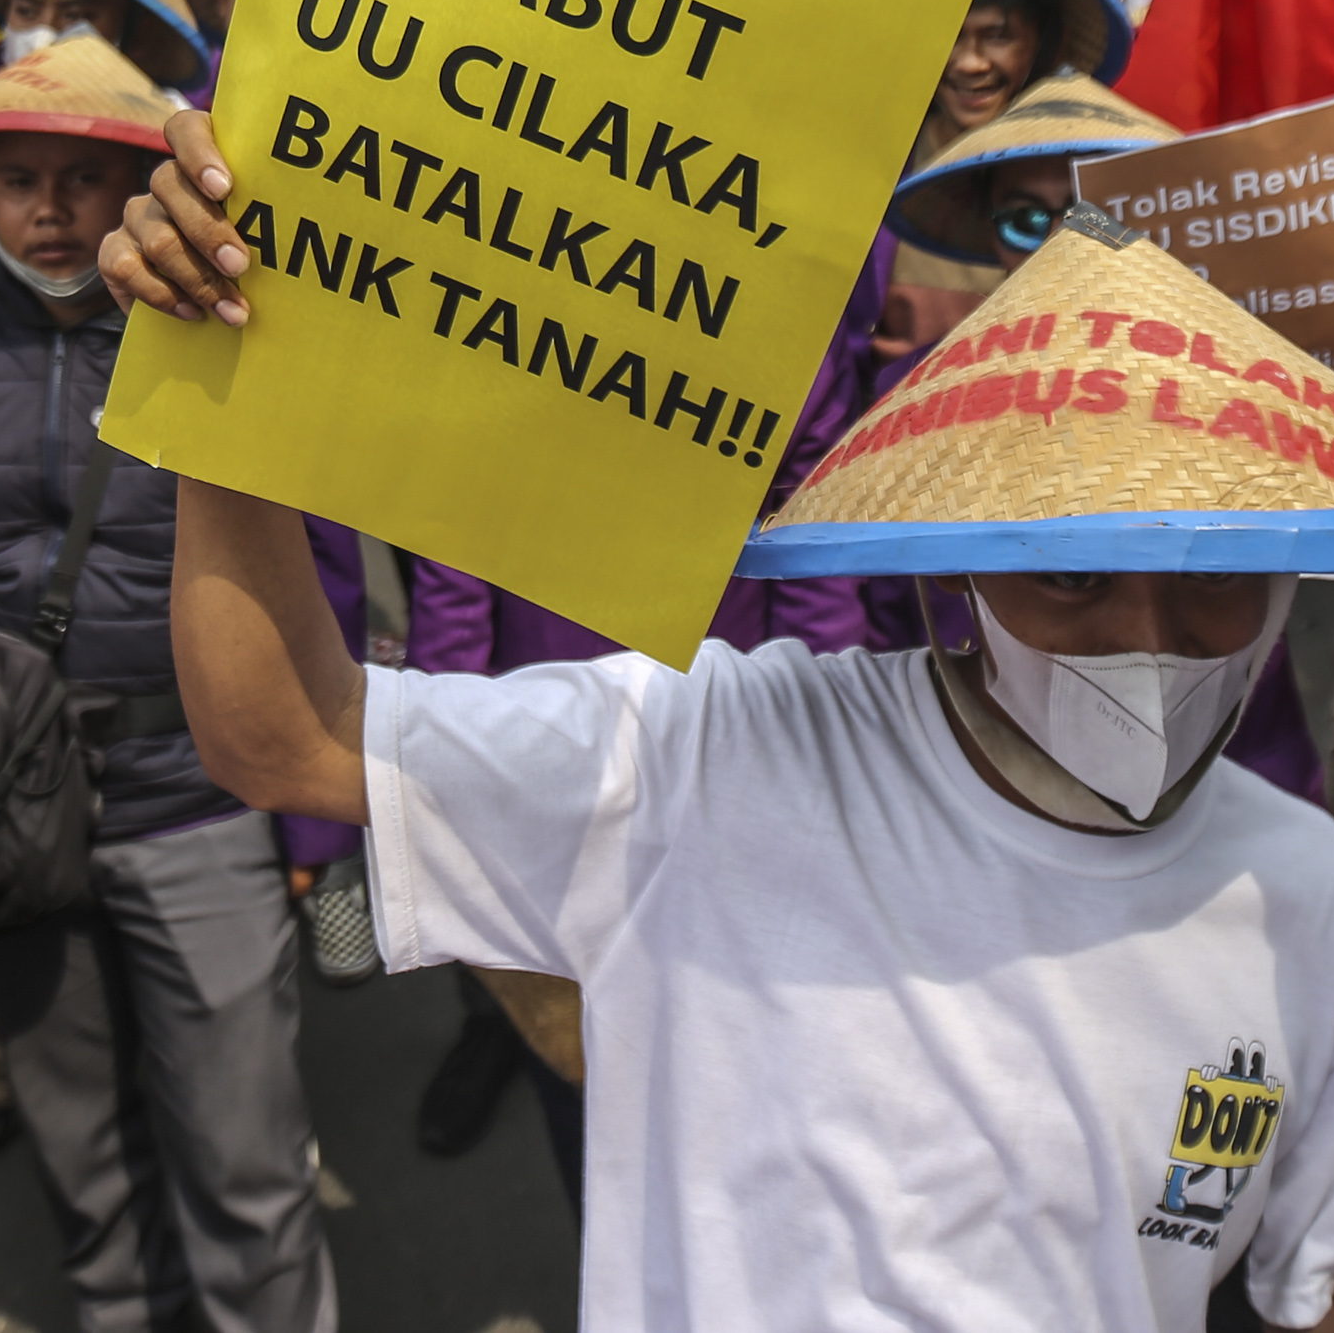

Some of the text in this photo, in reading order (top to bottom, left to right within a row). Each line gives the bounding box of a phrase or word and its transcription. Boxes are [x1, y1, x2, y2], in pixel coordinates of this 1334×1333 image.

[271, 94, 741, 340] BATALKAN
[439, 44, 787, 251] CILAKA,
[1107, 180, 1219, 222] Tolak
[236, 199, 780, 469] ANK TANAH!!
[1138, 1217, 1197, 1242] LOOK
